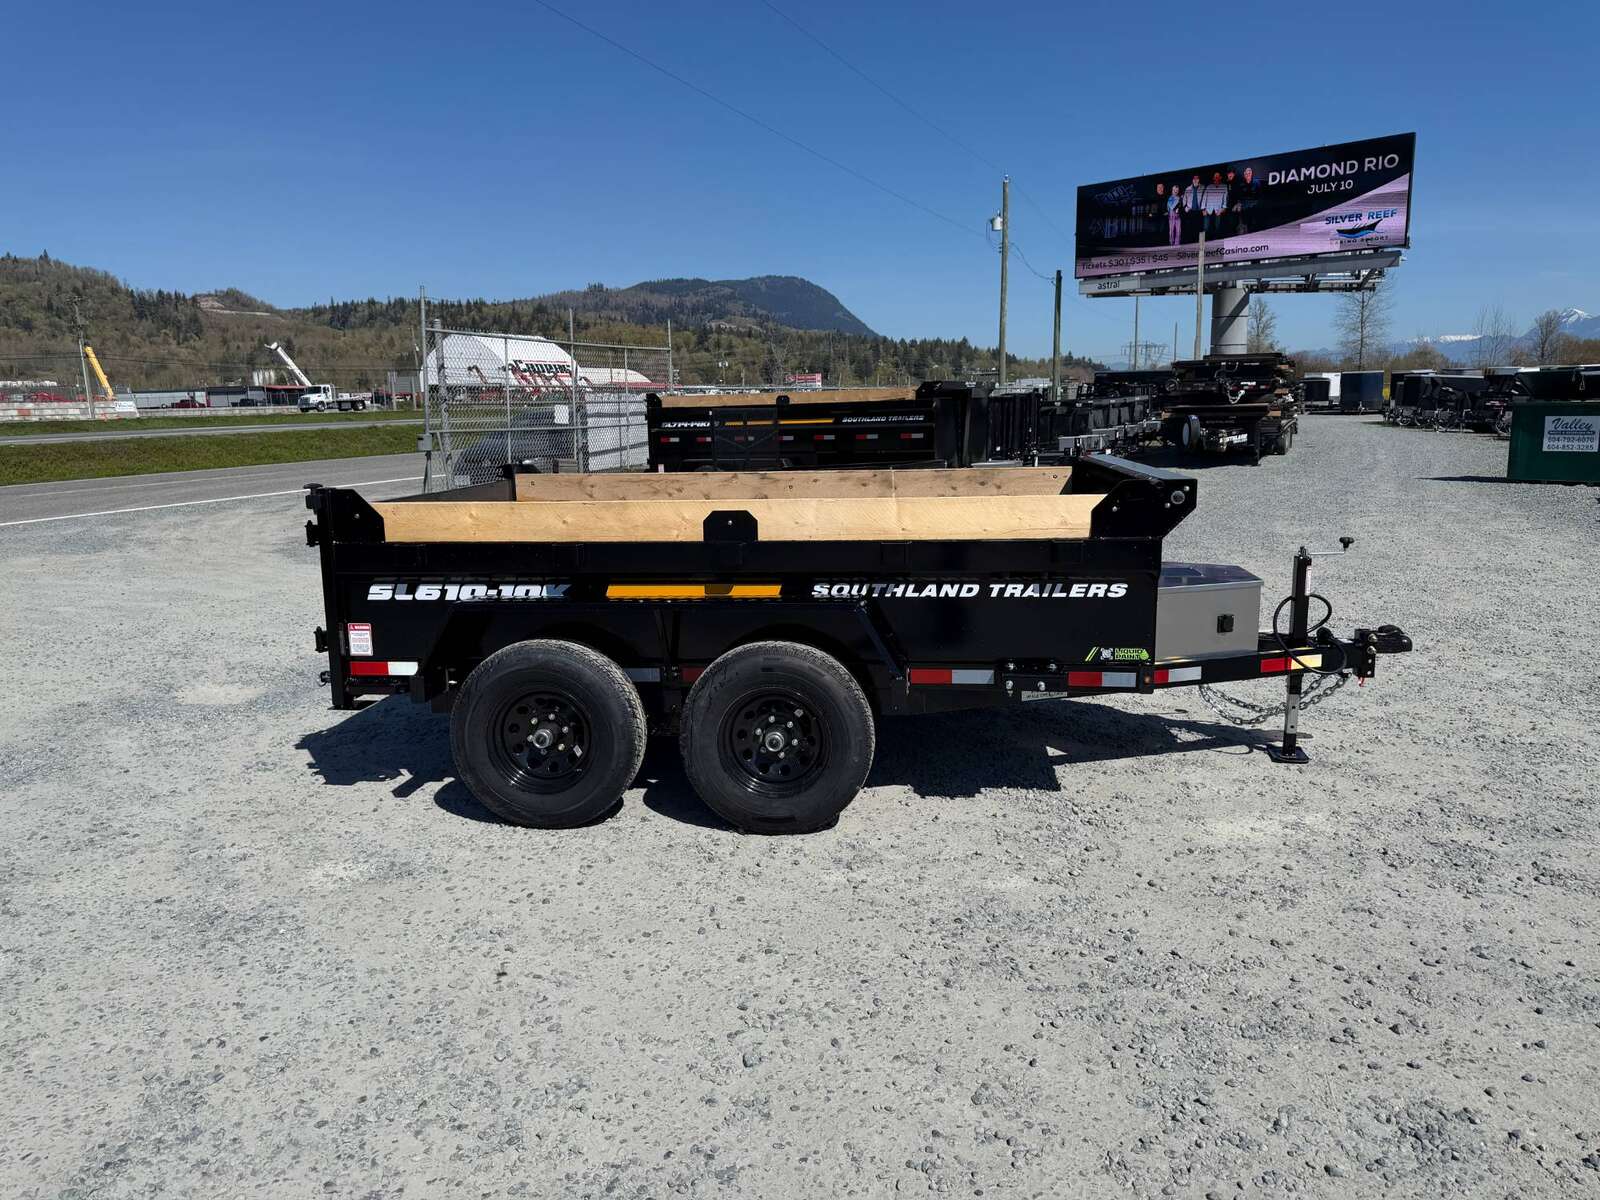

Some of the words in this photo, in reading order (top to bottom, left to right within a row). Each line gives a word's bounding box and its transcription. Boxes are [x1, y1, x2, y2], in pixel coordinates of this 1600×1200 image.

[1268, 160, 1358, 186] DIAMOND
[1364, 154, 1400, 172] RIO
[1307, 182, 1338, 194] JULY
[1340, 179, 1354, 190] 10
[1325, 213, 1363, 225] SILVER
[1367, 208, 1398, 220] REEF
[1097, 281, 1120, 290] astral
[1552, 418, 1593, 431] Valley
[367, 583, 572, 601] SL610-10K
[811, 583, 980, 598] SOUTHLAND
[989, 583, 1128, 598] TRAILERS
